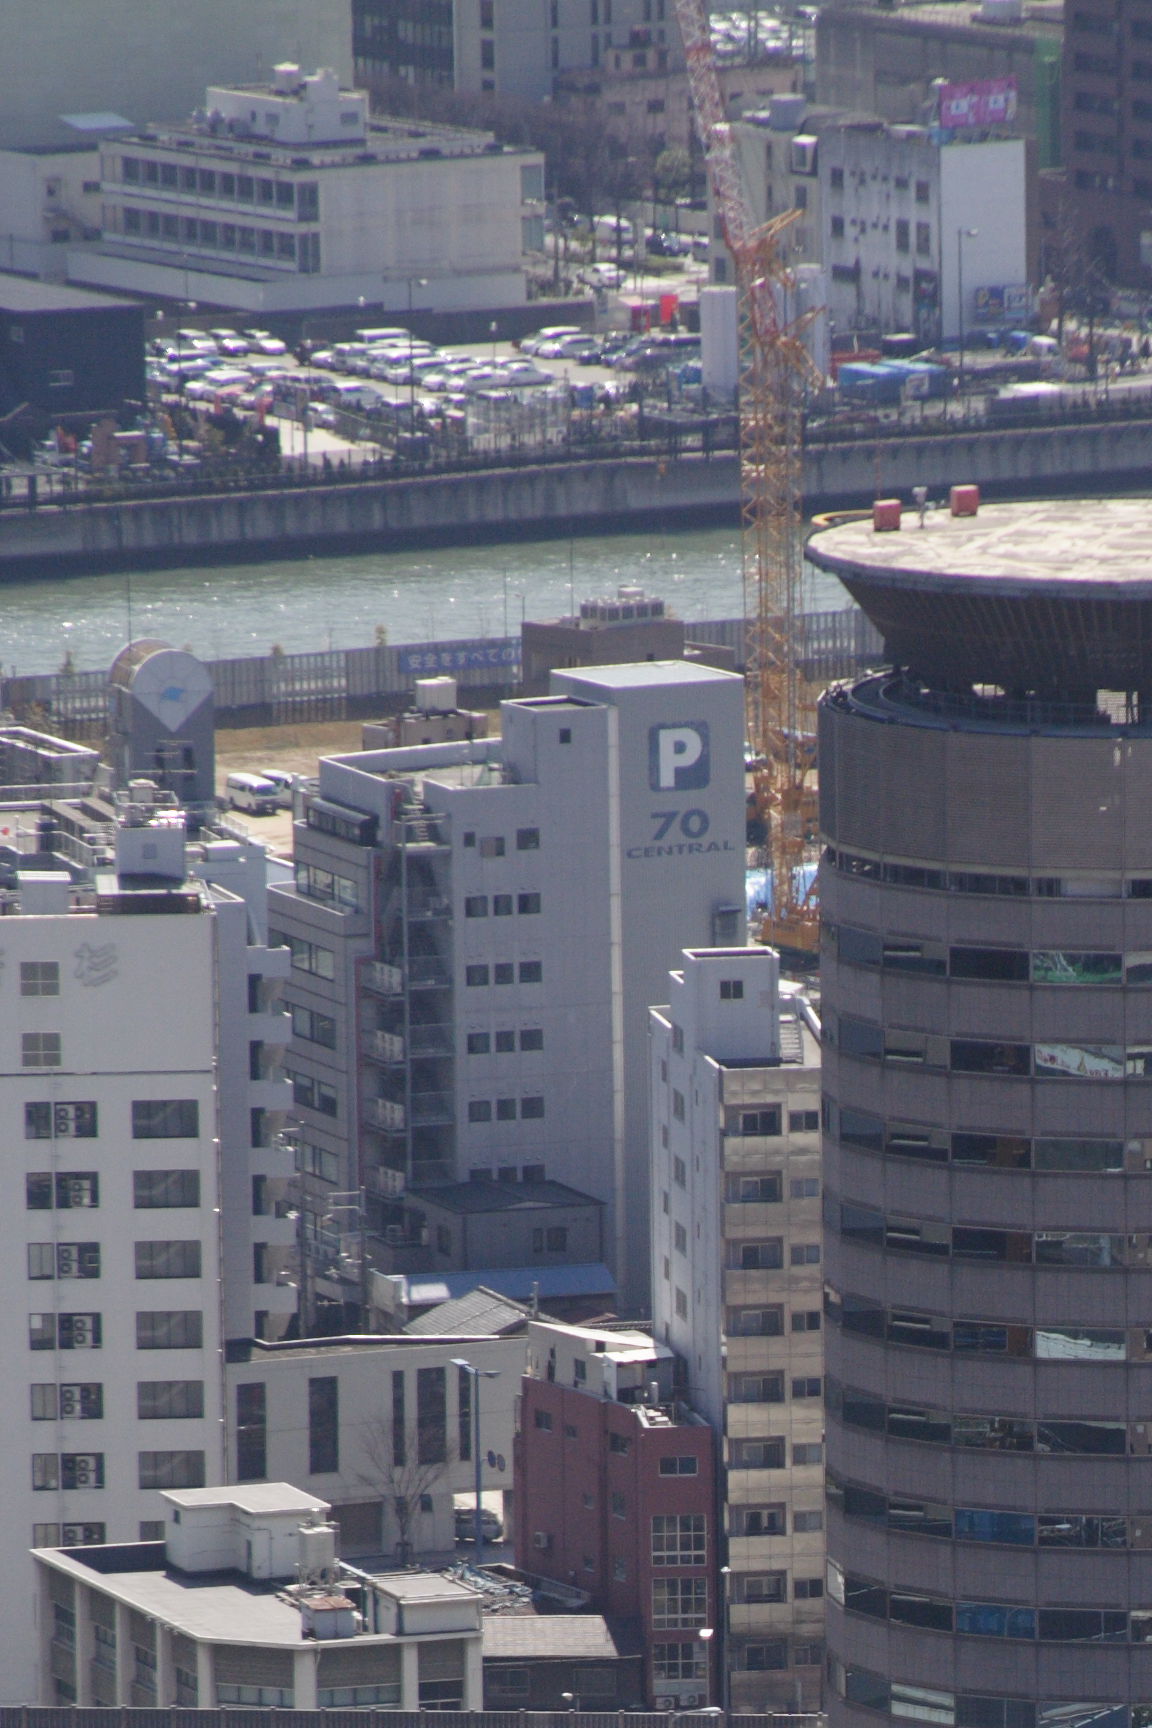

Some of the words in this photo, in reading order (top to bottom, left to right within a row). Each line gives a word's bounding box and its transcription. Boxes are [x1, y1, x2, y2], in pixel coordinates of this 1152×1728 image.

[659, 727, 702, 788] P
[651, 808, 710, 841] 70
[626, 840, 736, 860] CENTRAL
